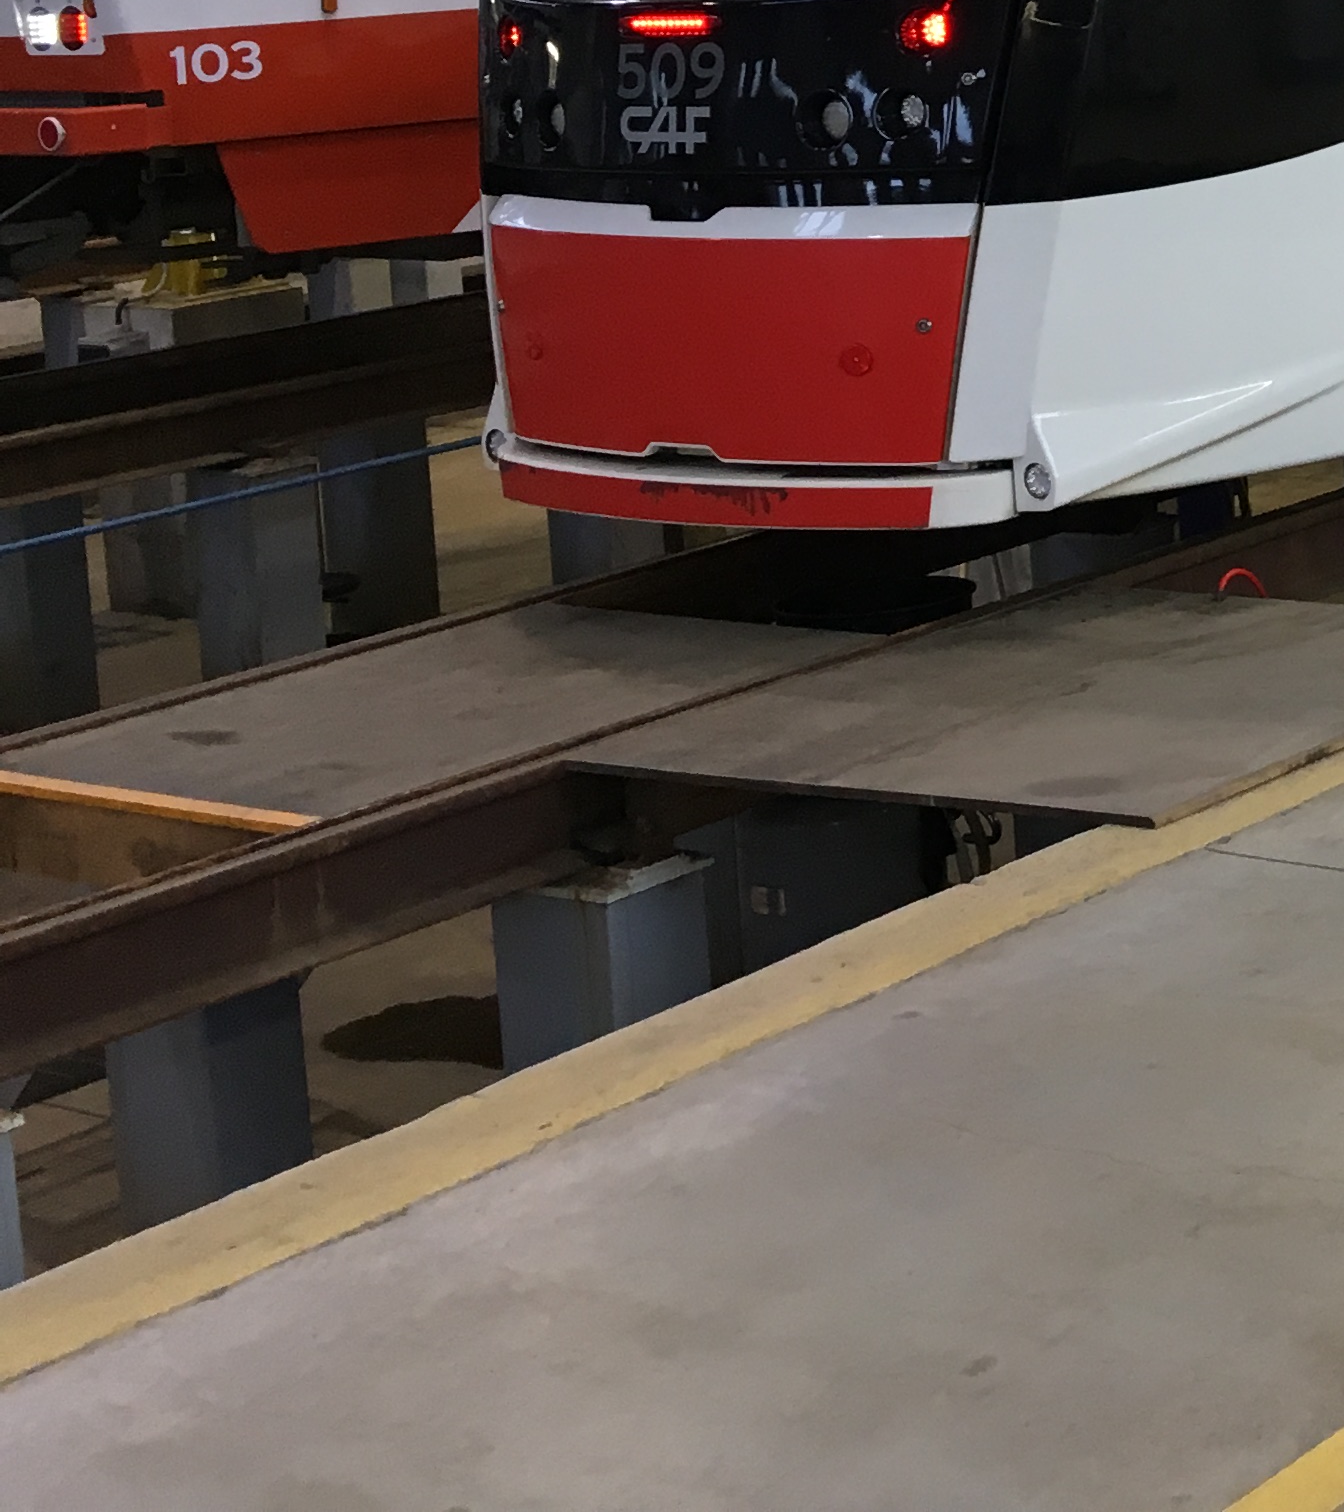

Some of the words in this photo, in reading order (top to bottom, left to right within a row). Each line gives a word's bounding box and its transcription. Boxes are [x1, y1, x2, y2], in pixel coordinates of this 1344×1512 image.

[168, 39, 264, 86] 103
[616, 41, 726, 100] 509
[619, 105, 711, 155] CAF
